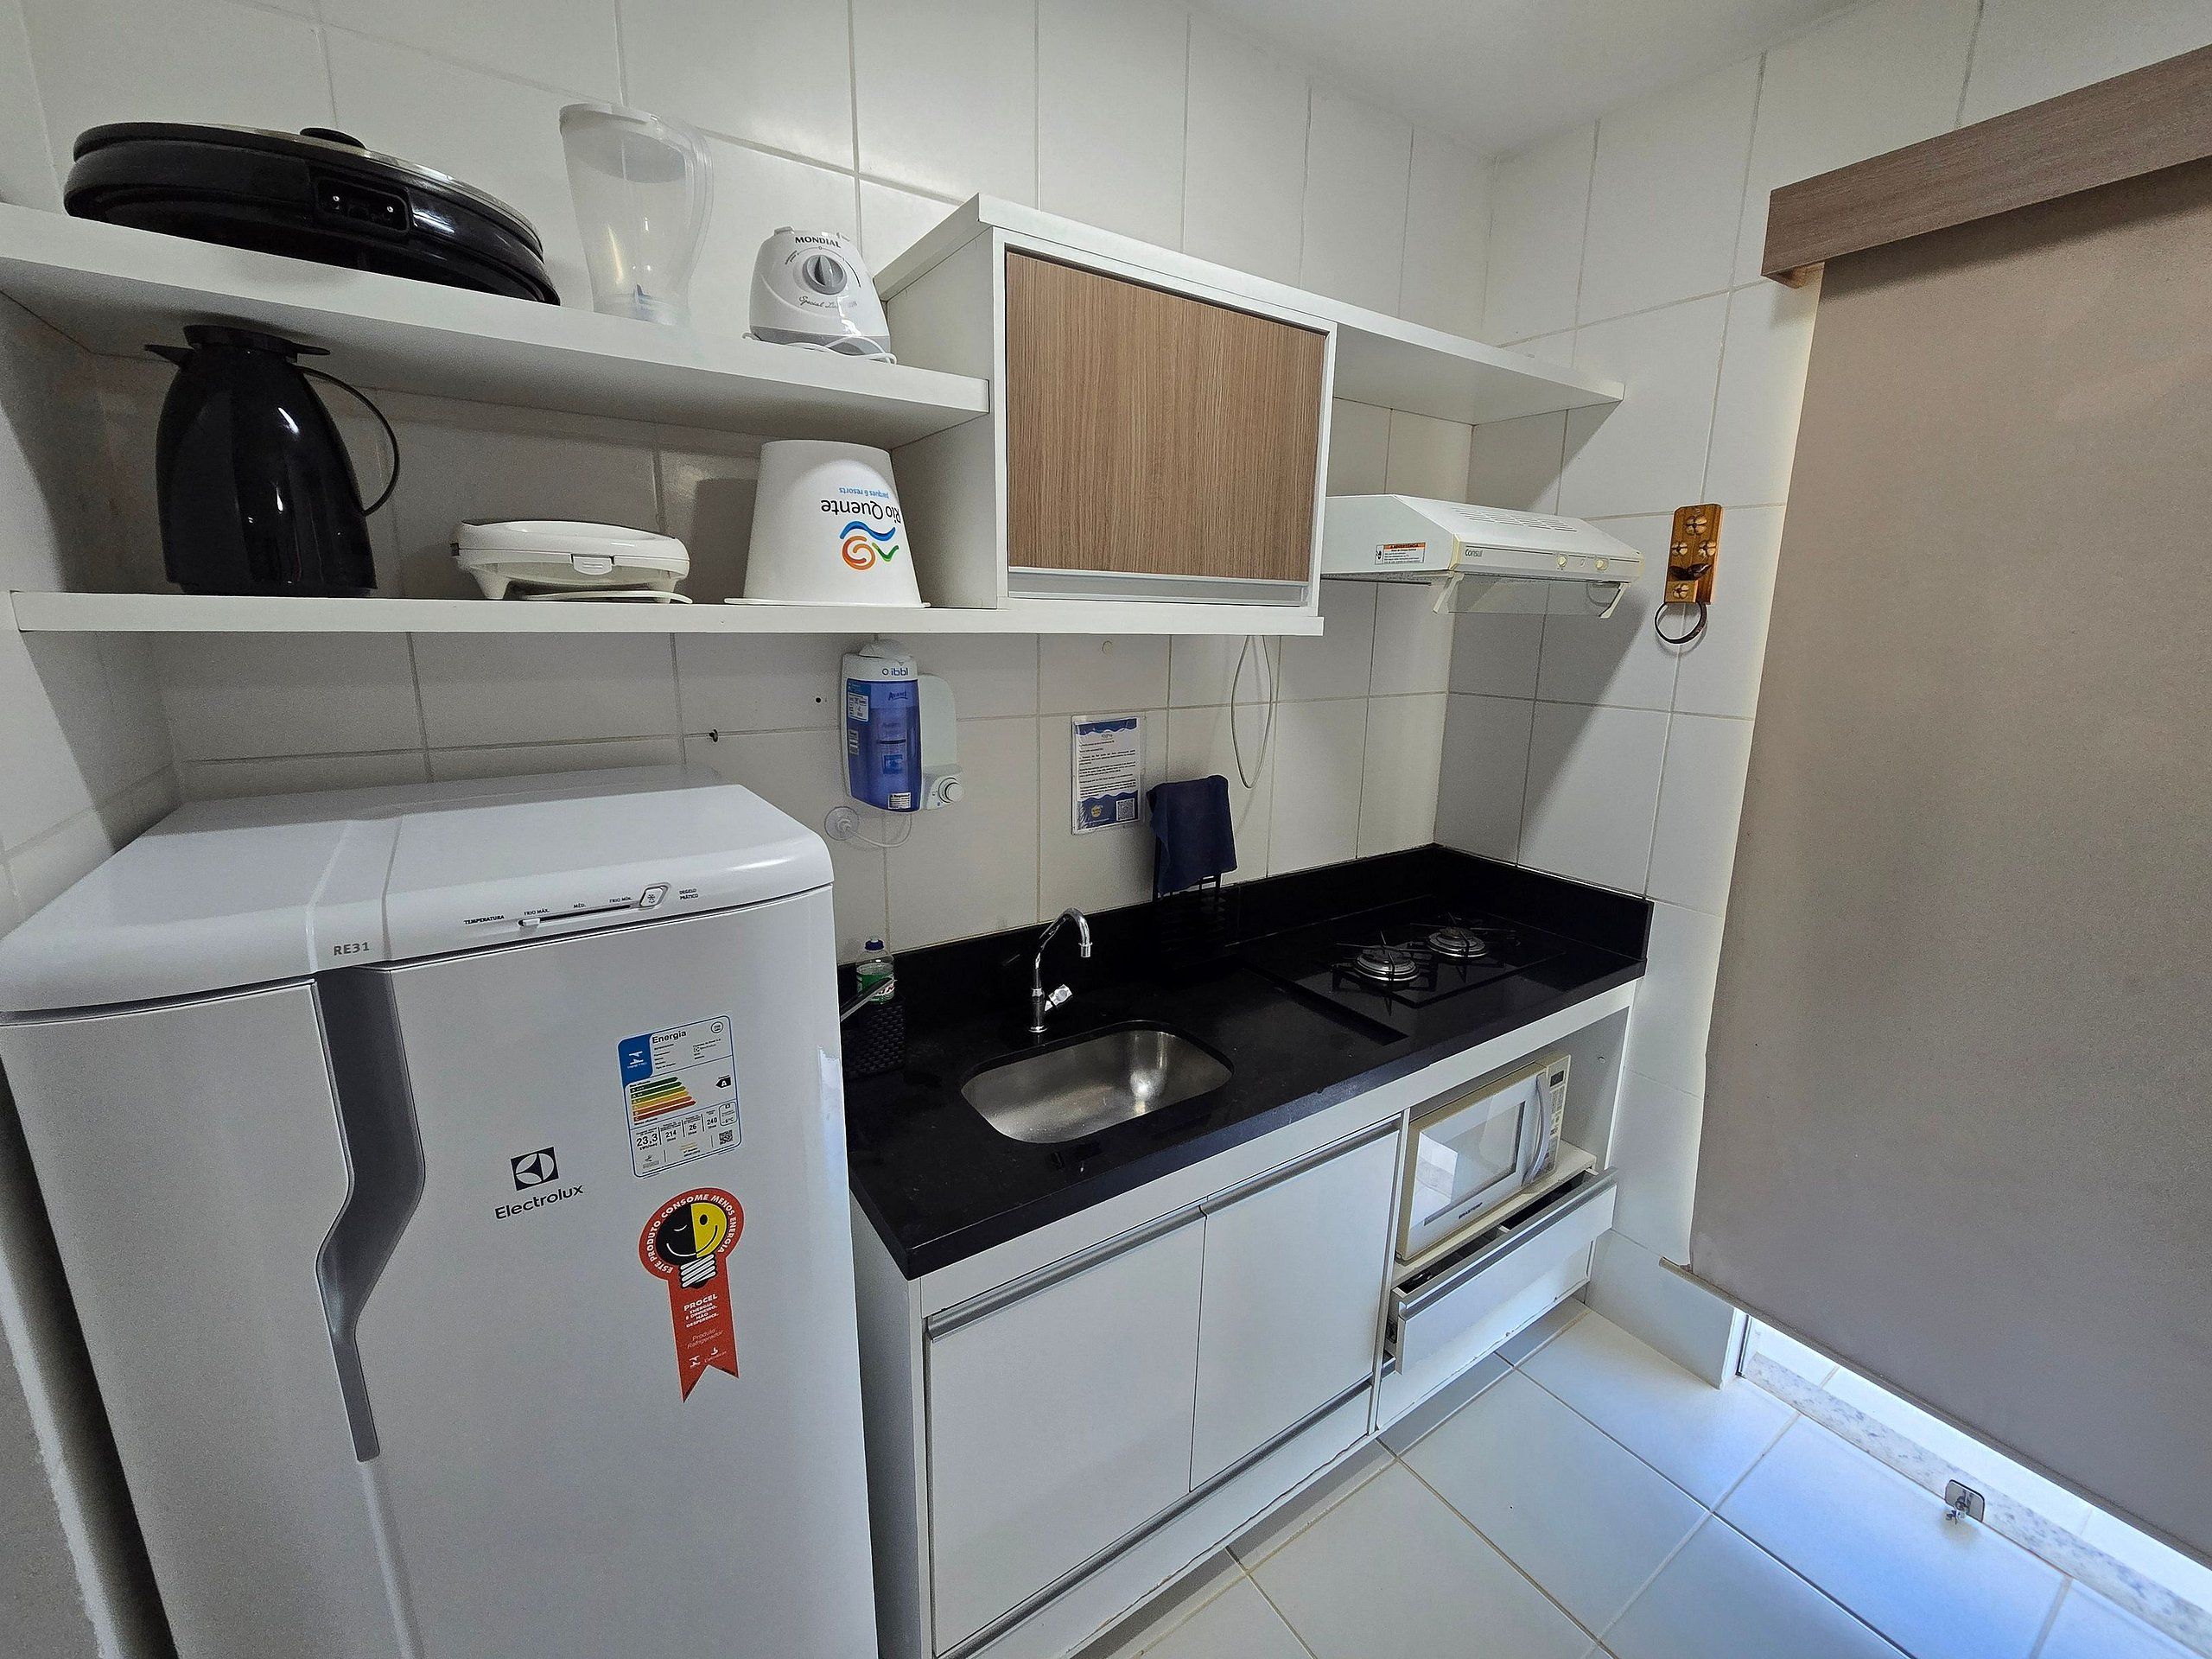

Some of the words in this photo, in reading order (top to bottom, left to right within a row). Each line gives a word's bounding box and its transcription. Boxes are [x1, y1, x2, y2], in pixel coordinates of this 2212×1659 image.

[795, 237, 841, 249] MONDIAL
[821, 499, 883, 520] Quente
[886, 505, 901, 524] Rio
[1465, 549, 1483, 557] Consul
[464, 915, 505, 925] TEMPERATURA
[334, 942, 370, 956] RE31
[652, 1030, 687, 1044] Energia
[664, 1129, 677, 1138] 214
[494, 1185, 584, 1220] Electrolux
[661, 1193, 709, 1219] CONSOME
[710, 1195, 735, 1216] MENOS
[646, 1220, 661, 1262] PRODUTO
[717, 1217, 737, 1254] ENERGIA
[655, 1261, 674, 1274] ESTE
[683, 1294, 718, 1312] PROCEL
